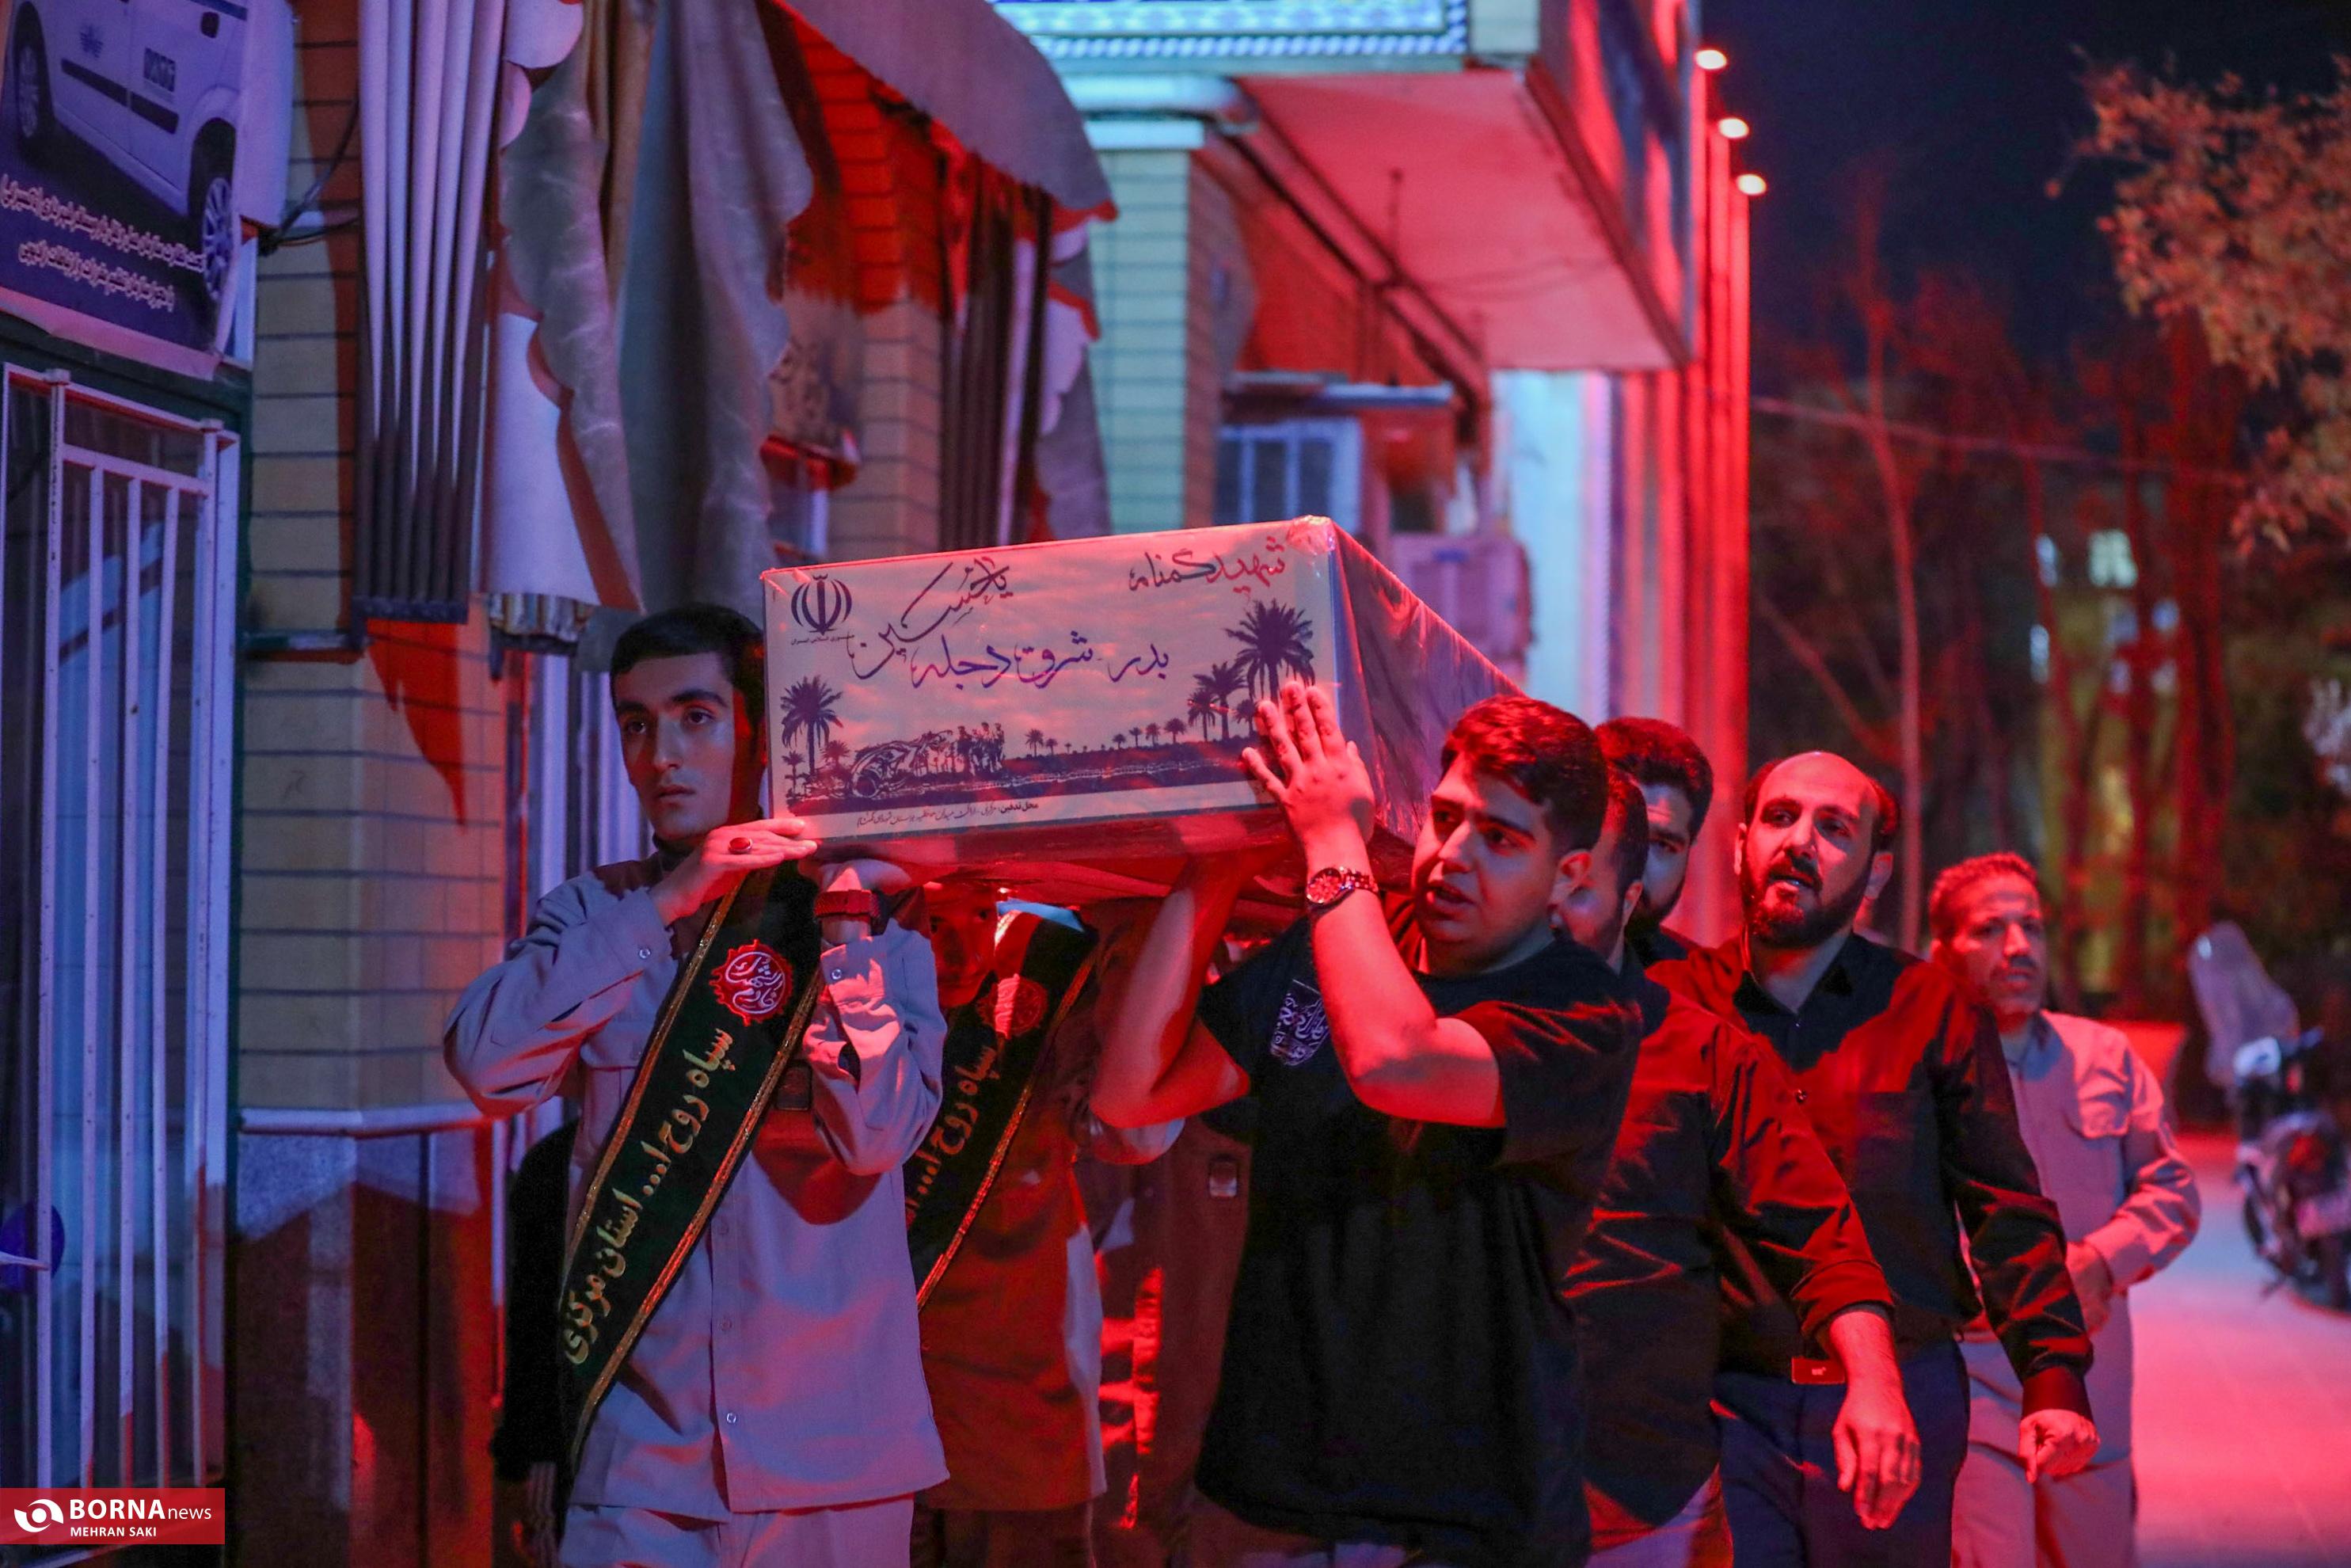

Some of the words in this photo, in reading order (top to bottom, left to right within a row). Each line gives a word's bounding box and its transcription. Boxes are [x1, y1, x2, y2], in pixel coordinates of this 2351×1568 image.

[1128, 548, 1217, 592] گمنام
[1207, 535, 1286, 595] شهید
[910, 634, 1012, 691] دجله
[1014, 630, 1094, 689] شرق
[1108, 642, 1170, 683] بدر
[1021, 802, 1039, 813] محل
[683, 1028, 736, 1088] سپاه
[658, 1094, 709, 1155] روح
[929, 1102, 979, 1155] روح
[595, 1186, 643, 1278] استان
[565, 1273, 611, 1364] مرکزی
